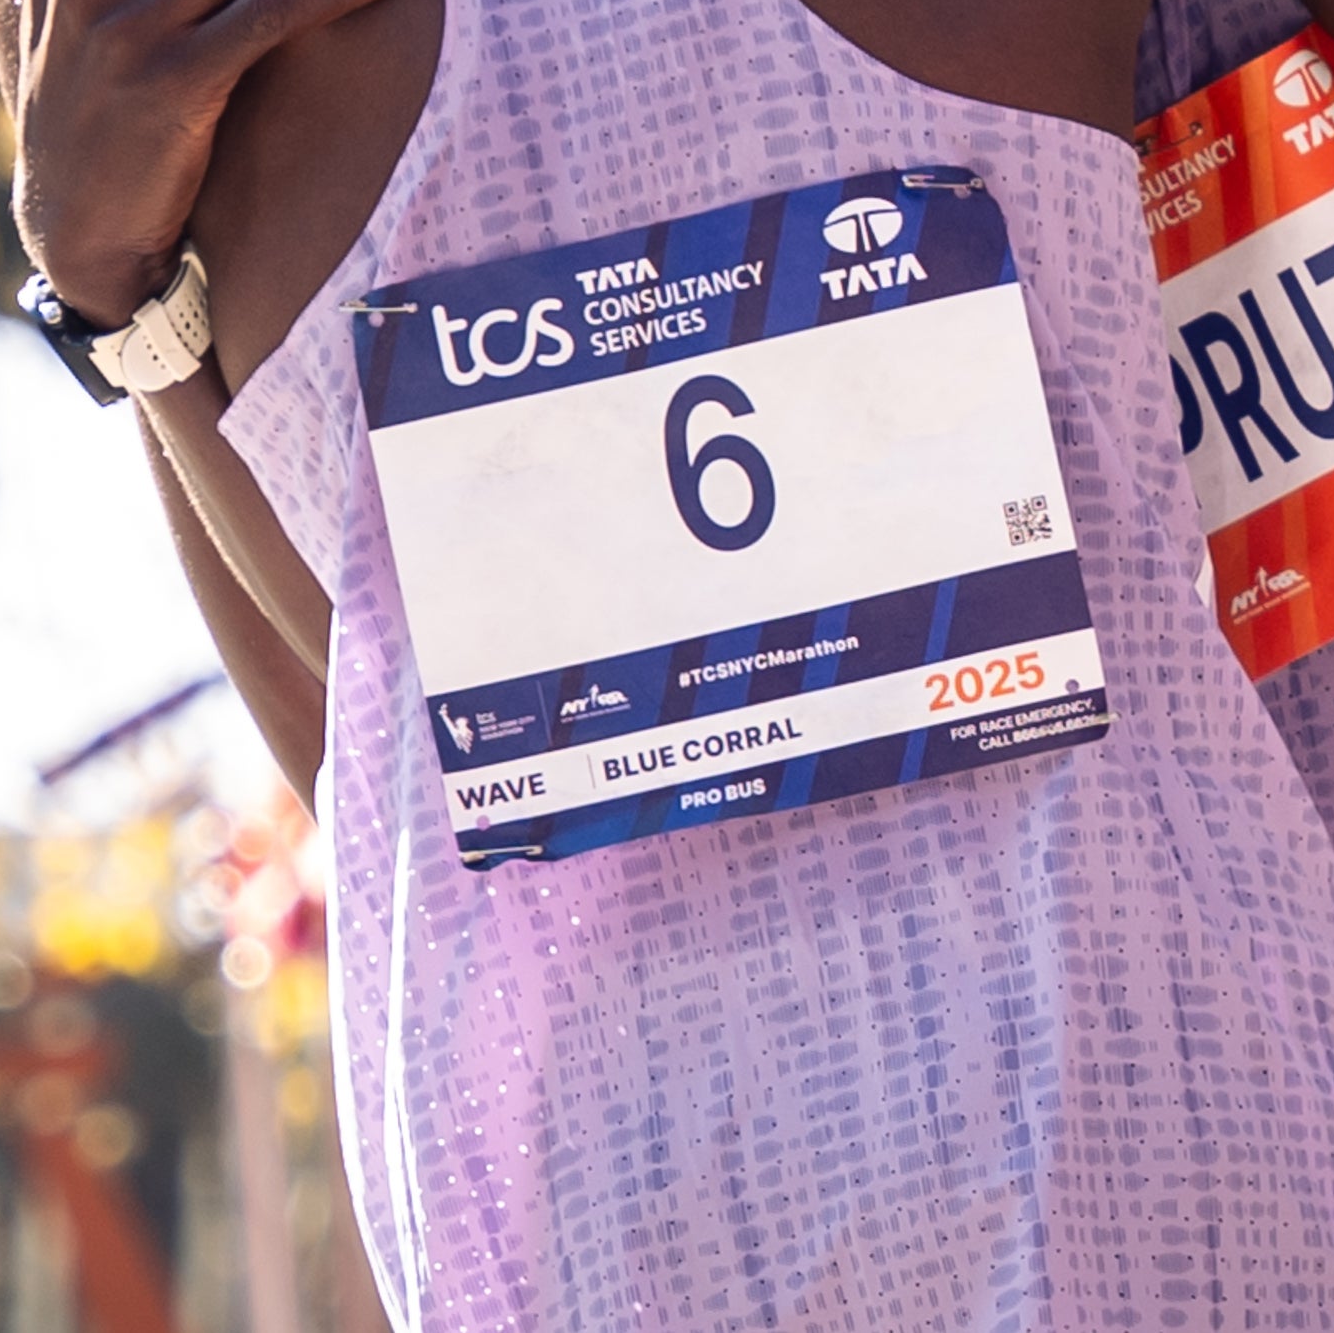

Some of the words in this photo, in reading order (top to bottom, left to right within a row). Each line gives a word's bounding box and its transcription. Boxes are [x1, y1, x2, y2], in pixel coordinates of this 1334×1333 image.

[575, 257, 660, 296] TATA
[583, 261, 764, 326] CONSULTANCY
[819, 253, 928, 301] TATA
[432, 298, 575, 386] tcs
[589, 308, 708, 357] SERVICES
[663, 373, 778, 553] 6
[679, 634, 860, 689] #TCSNYCMarathon
[924, 651, 1046, 712] 2025
[950, 726, 978, 742] FOR
[979, 716, 1014, 735] RACE
[978, 733, 1013, 751] CALL
[456, 773, 547, 811] WAVE
[602, 745, 677, 781] BLUE
[682, 718, 804, 762] CORRAL
[680, 789, 720, 810] PRO
[726, 778, 767, 800] BUS
